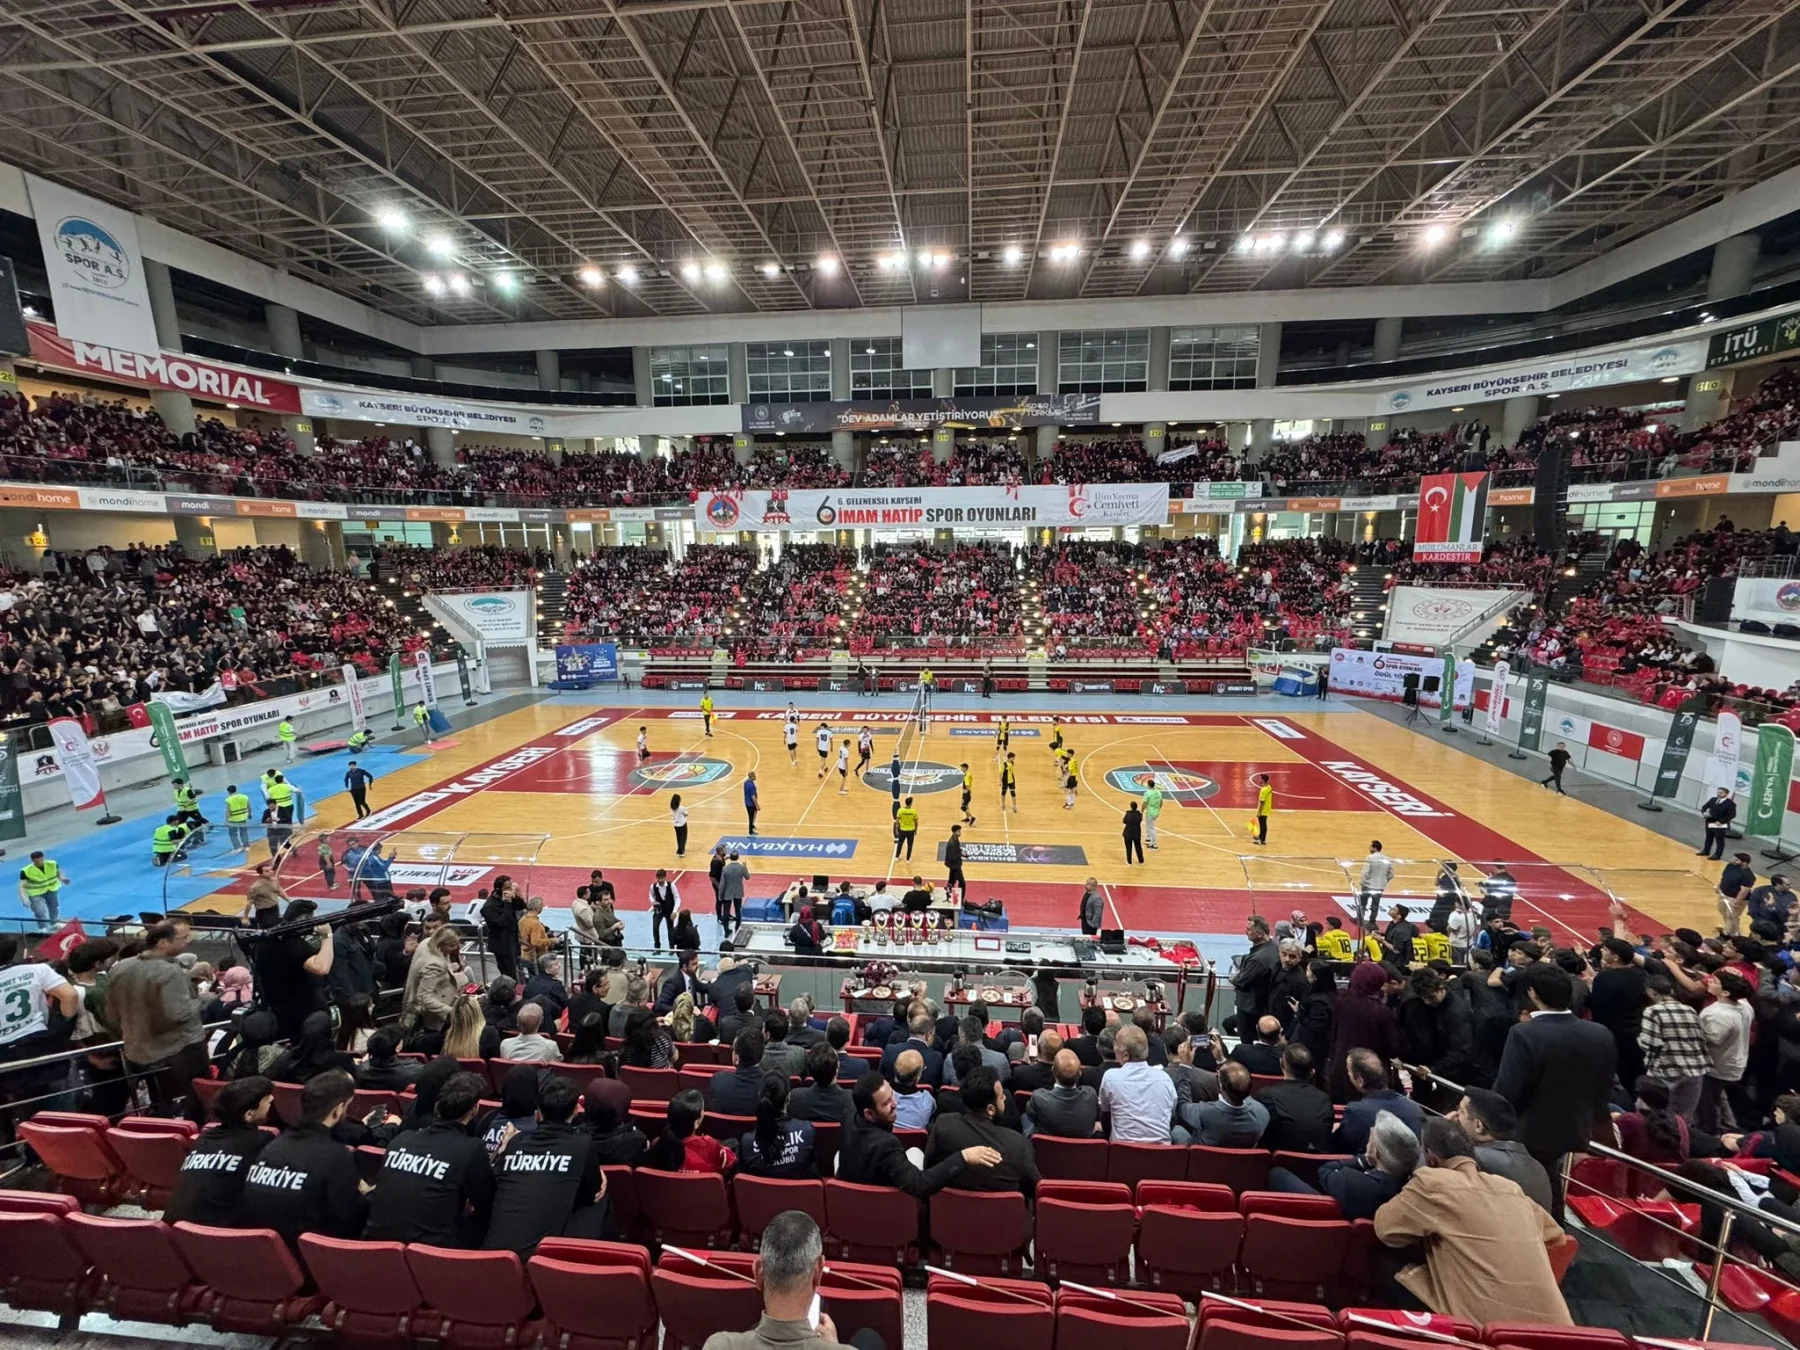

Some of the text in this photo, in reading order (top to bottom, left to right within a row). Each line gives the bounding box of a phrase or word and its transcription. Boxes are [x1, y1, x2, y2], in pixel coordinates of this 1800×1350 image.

[65, 253, 100, 271] SPOR
[72, 340, 270, 405] MEMORIAL
[1427, 359, 1628, 397] KAYSERİ BÜYÜKŞEHİR BELEDİYESİ
[1484, 386, 1520, 397] SPOR
[865, 411, 915, 423] ADAMLAR
[99, 497, 159, 508] mondihome
[847, 497, 890, 506] GELENEKSEL
[891, 495, 922, 506] KAYSERİ
[1094, 499, 1139, 511] Cemiyeti
[838, 506, 1036, 524] İMAM HATİP SPOR OYUNLARI
[1422, 552, 1471, 562] KARDEŞTİR
[194, 724, 219, 738] HATİP
[220, 719, 242, 731] SPOR
[244, 709, 280, 726] OYUNLARI
[756, 711, 843, 720] KASERİ
[991, 712, 1109, 723] BELEDYESİ
[437, 747, 558, 794] KAYSERİ
[1319, 761, 1456, 817] KAYSERİ
[726, 841, 826, 854] HALKBANK
[1338, 938, 1351, 954] 18
[5, 989, 31, 1022] 3
[384, 1148, 450, 1180] TÜRKİYE
[503, 1151, 571, 1172] TÜRKİYE
[246, 1161, 308, 1190] TÜRKİYE
